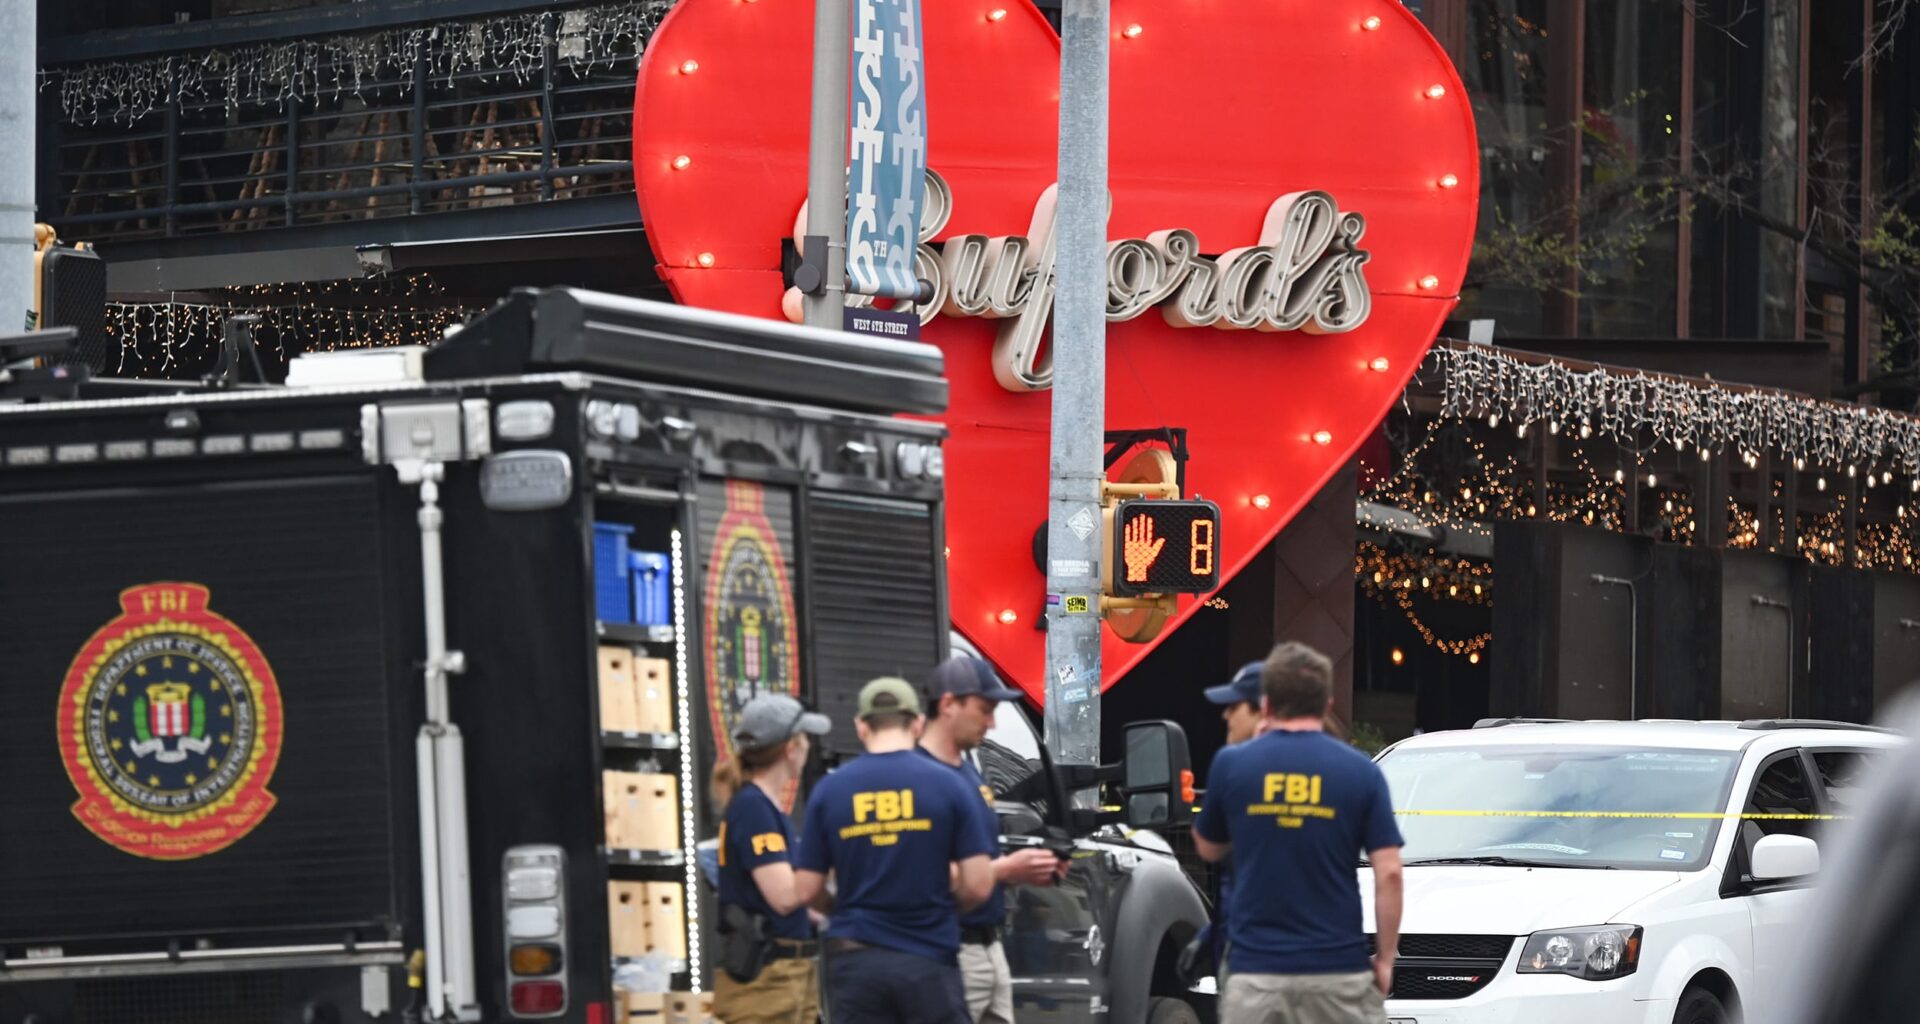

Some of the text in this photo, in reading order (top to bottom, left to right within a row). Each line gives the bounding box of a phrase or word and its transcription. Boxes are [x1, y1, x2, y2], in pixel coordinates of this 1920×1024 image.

[853, 318, 909, 335] WEST 6TH STREET
[1190, 519, 1214, 575] 8
[142, 590, 188, 615] FBI
[1264, 772, 1321, 804] FBI
[852, 789, 914, 823] FBI
[752, 832, 787, 855] FB
